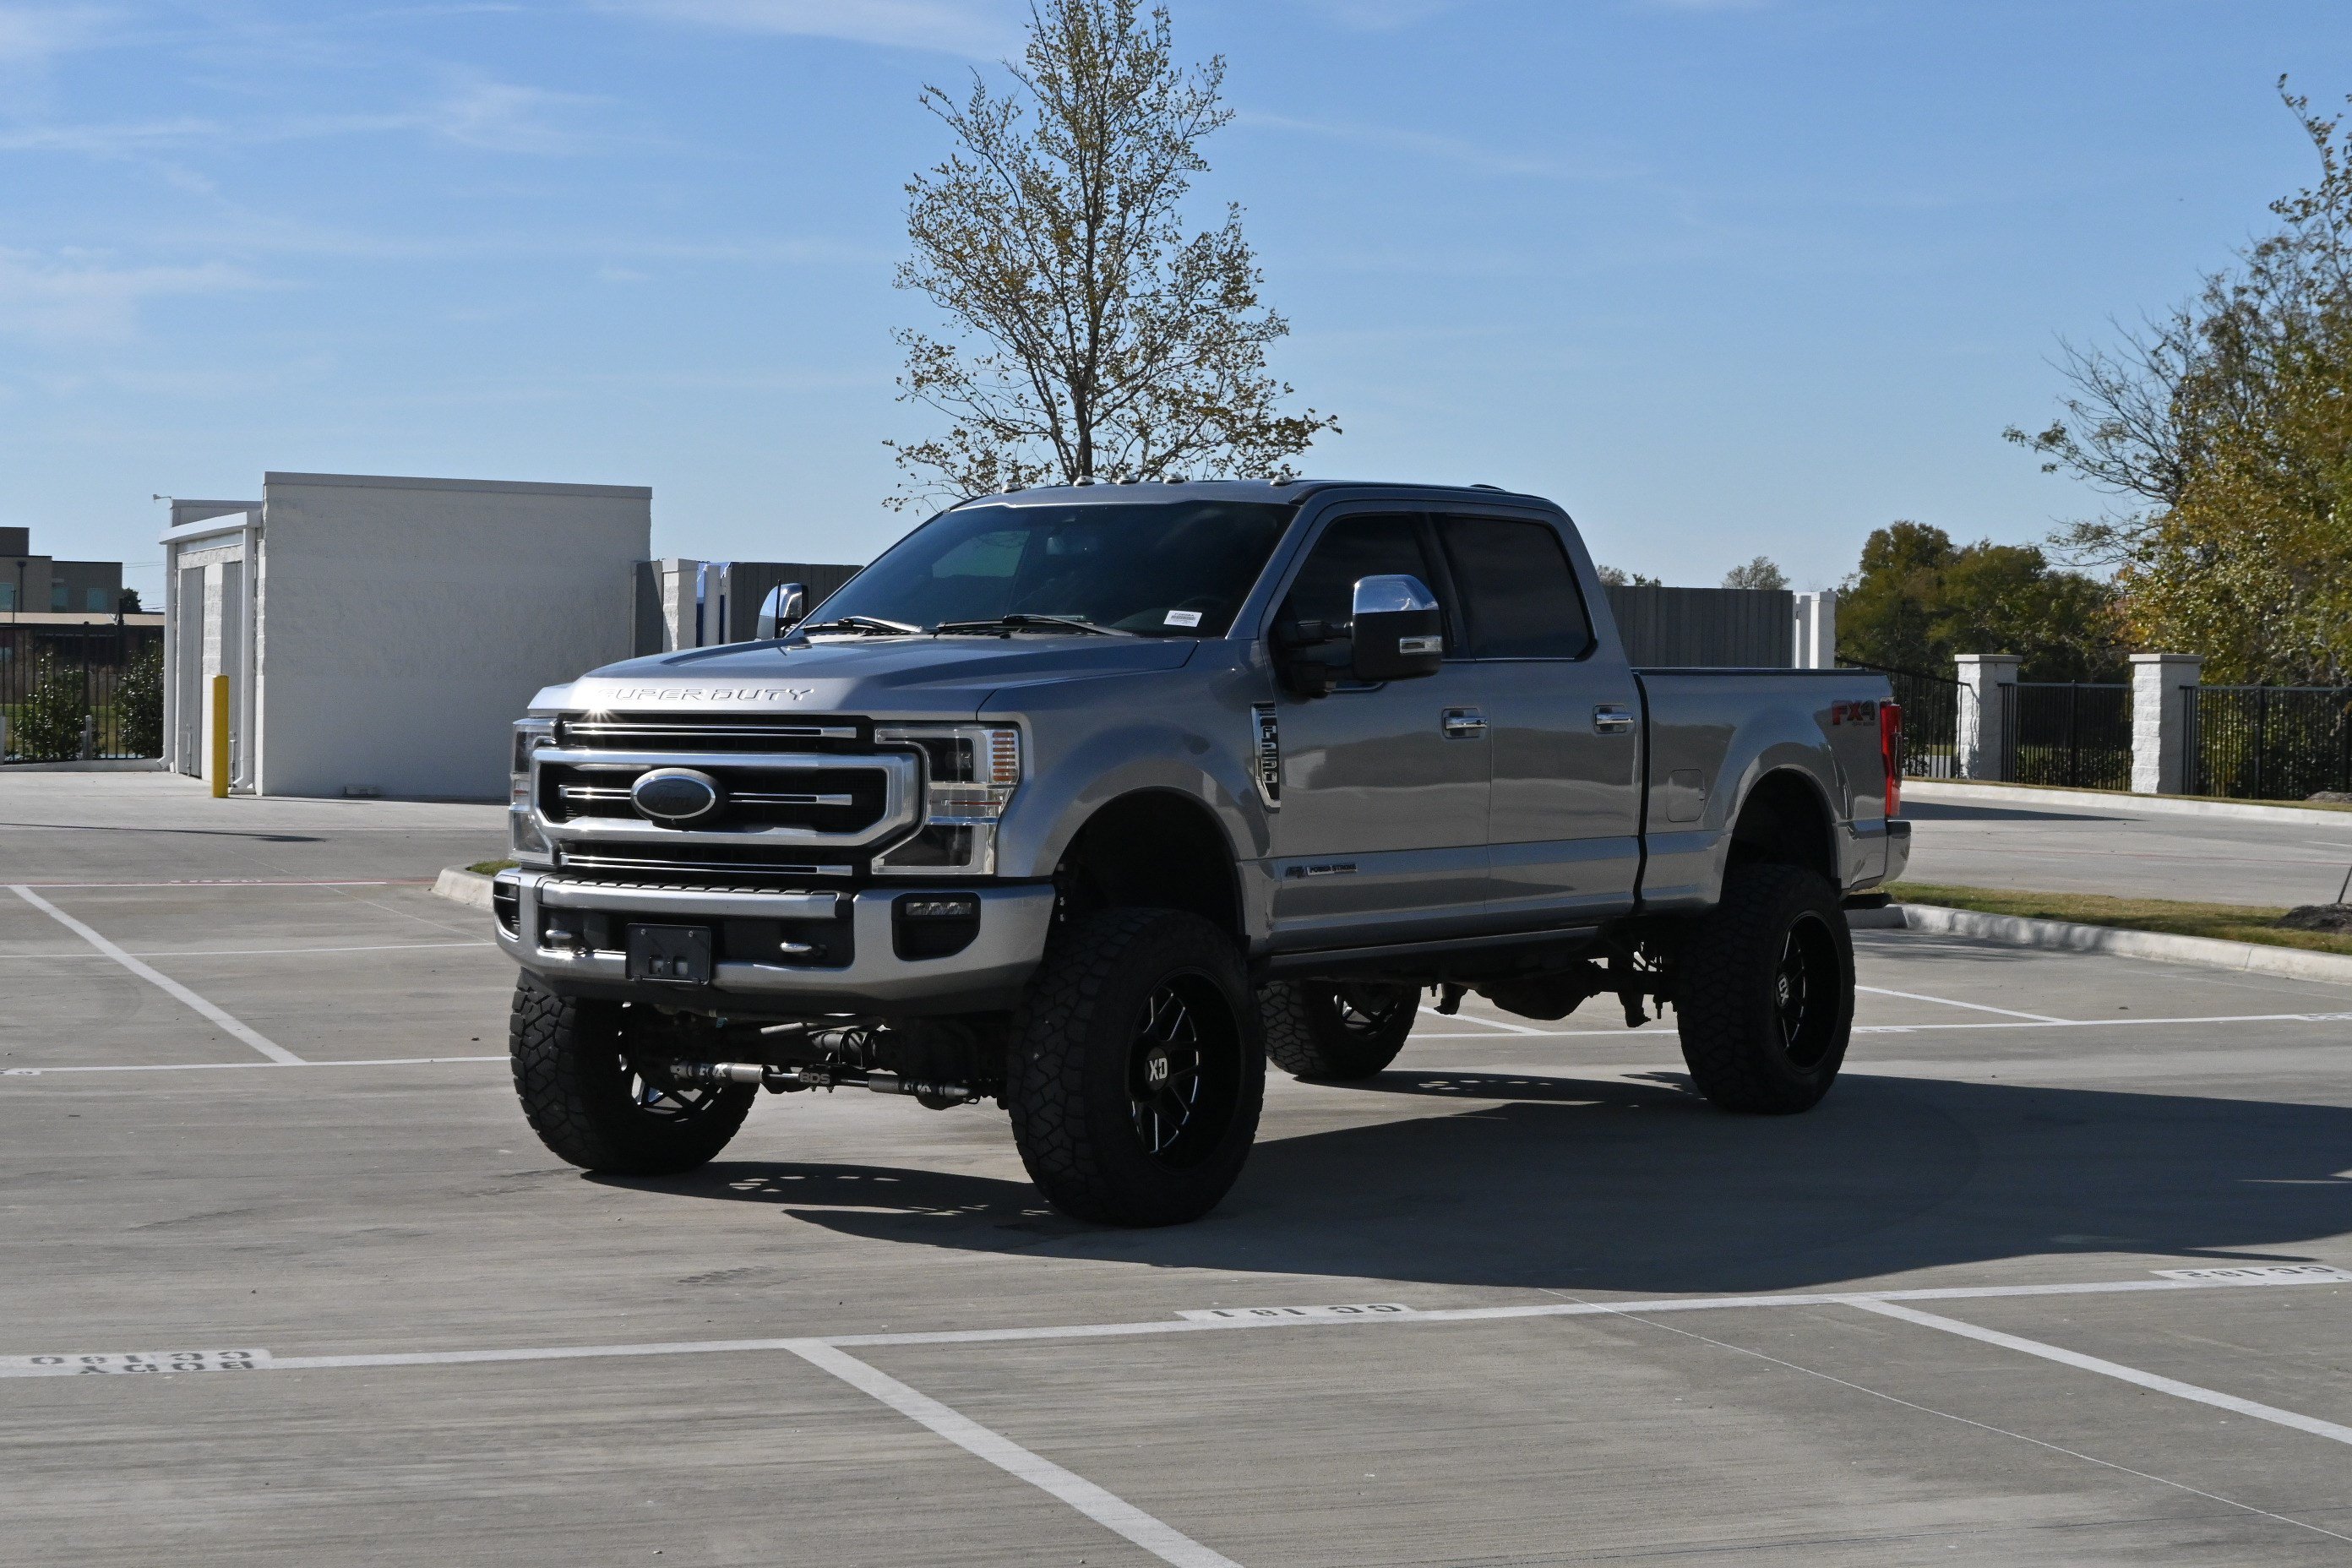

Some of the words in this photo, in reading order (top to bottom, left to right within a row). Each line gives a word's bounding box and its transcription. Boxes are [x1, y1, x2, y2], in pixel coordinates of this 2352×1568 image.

[710, 688, 815, 701] DUTY
[1832, 700, 1875, 725] FX4
[799, 1071, 830, 1084] BDS
[1149, 1058, 1168, 1081] XD
